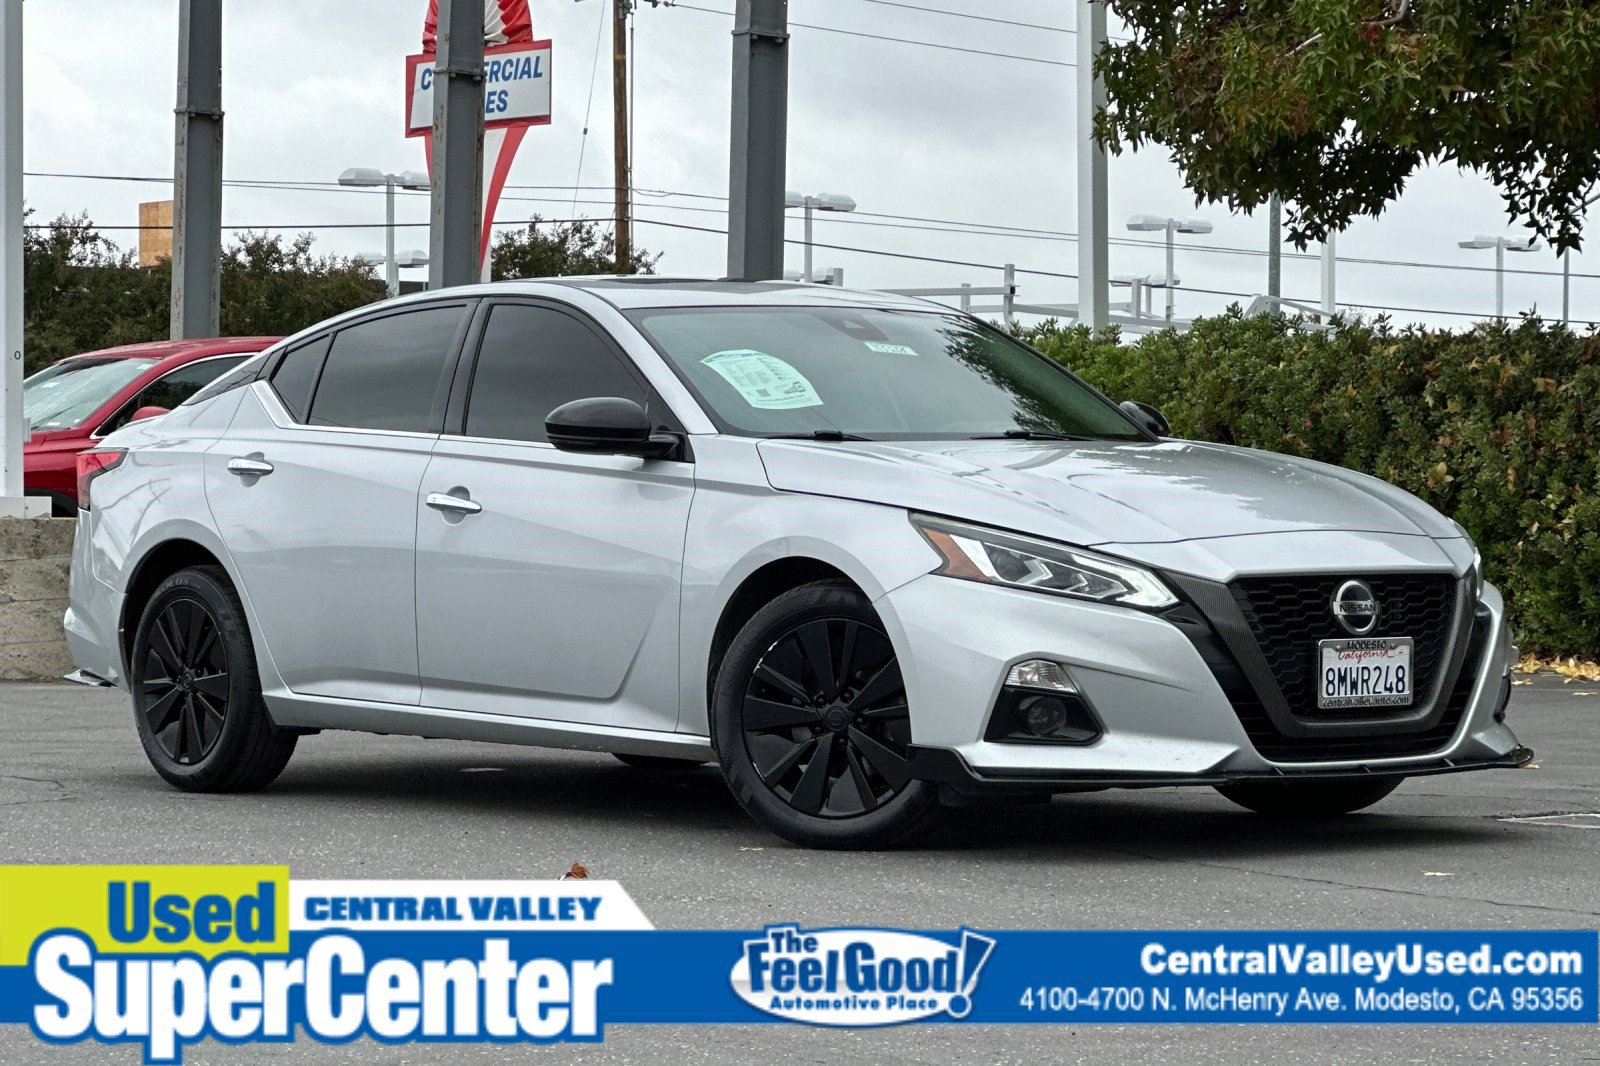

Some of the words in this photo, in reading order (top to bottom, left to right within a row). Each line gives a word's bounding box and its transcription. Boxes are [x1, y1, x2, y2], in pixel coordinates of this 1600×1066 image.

[421, 56, 543, 90] CRCIAL
[1339, 602, 1376, 612] NISSAN
[1347, 640, 1387, 650] MODESTO
[1325, 665, 1406, 697] 8MWR248
